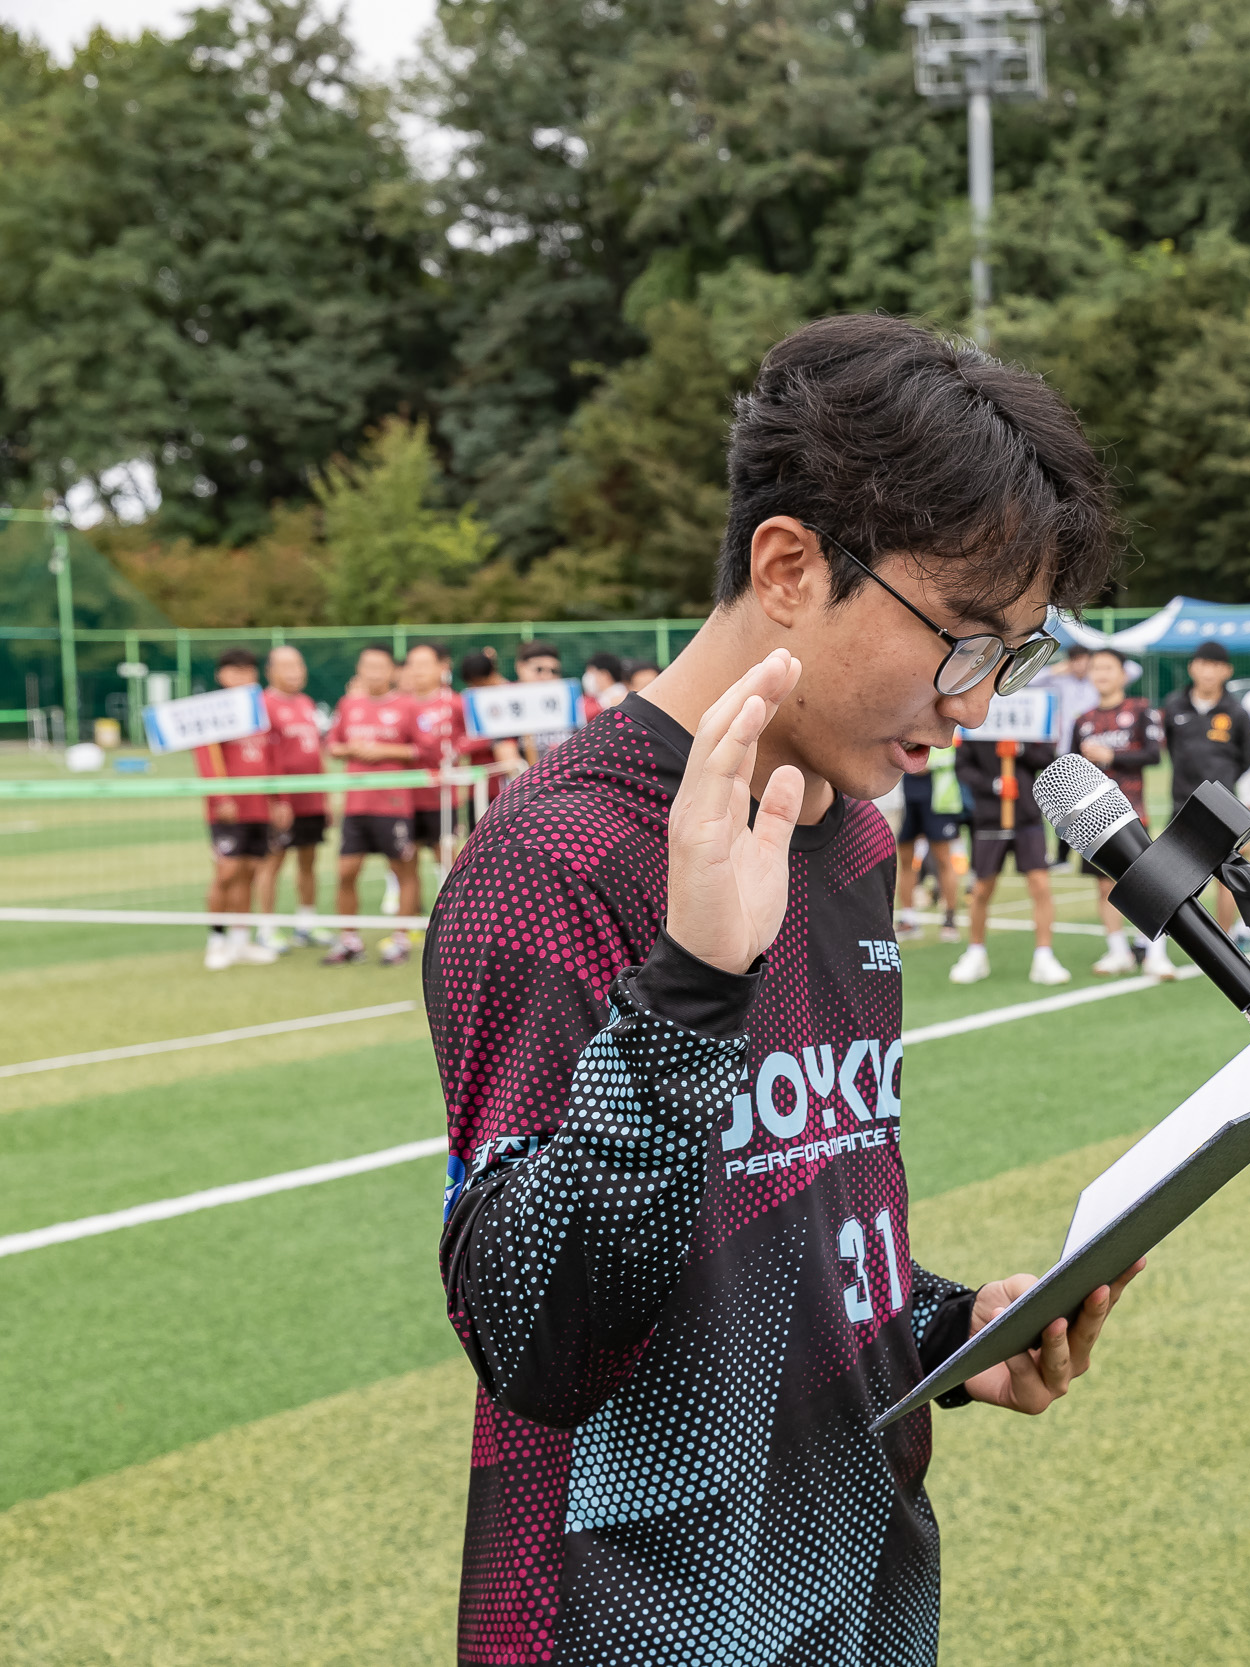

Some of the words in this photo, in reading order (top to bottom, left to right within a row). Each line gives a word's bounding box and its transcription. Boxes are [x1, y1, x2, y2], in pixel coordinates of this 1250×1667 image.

[858, 940, 902, 972] 그린족
[721, 1038, 903, 1152] JOYKIC
[725, 1127, 887, 1180] PERFORMANCE
[836, 1205, 904, 1326] 31
